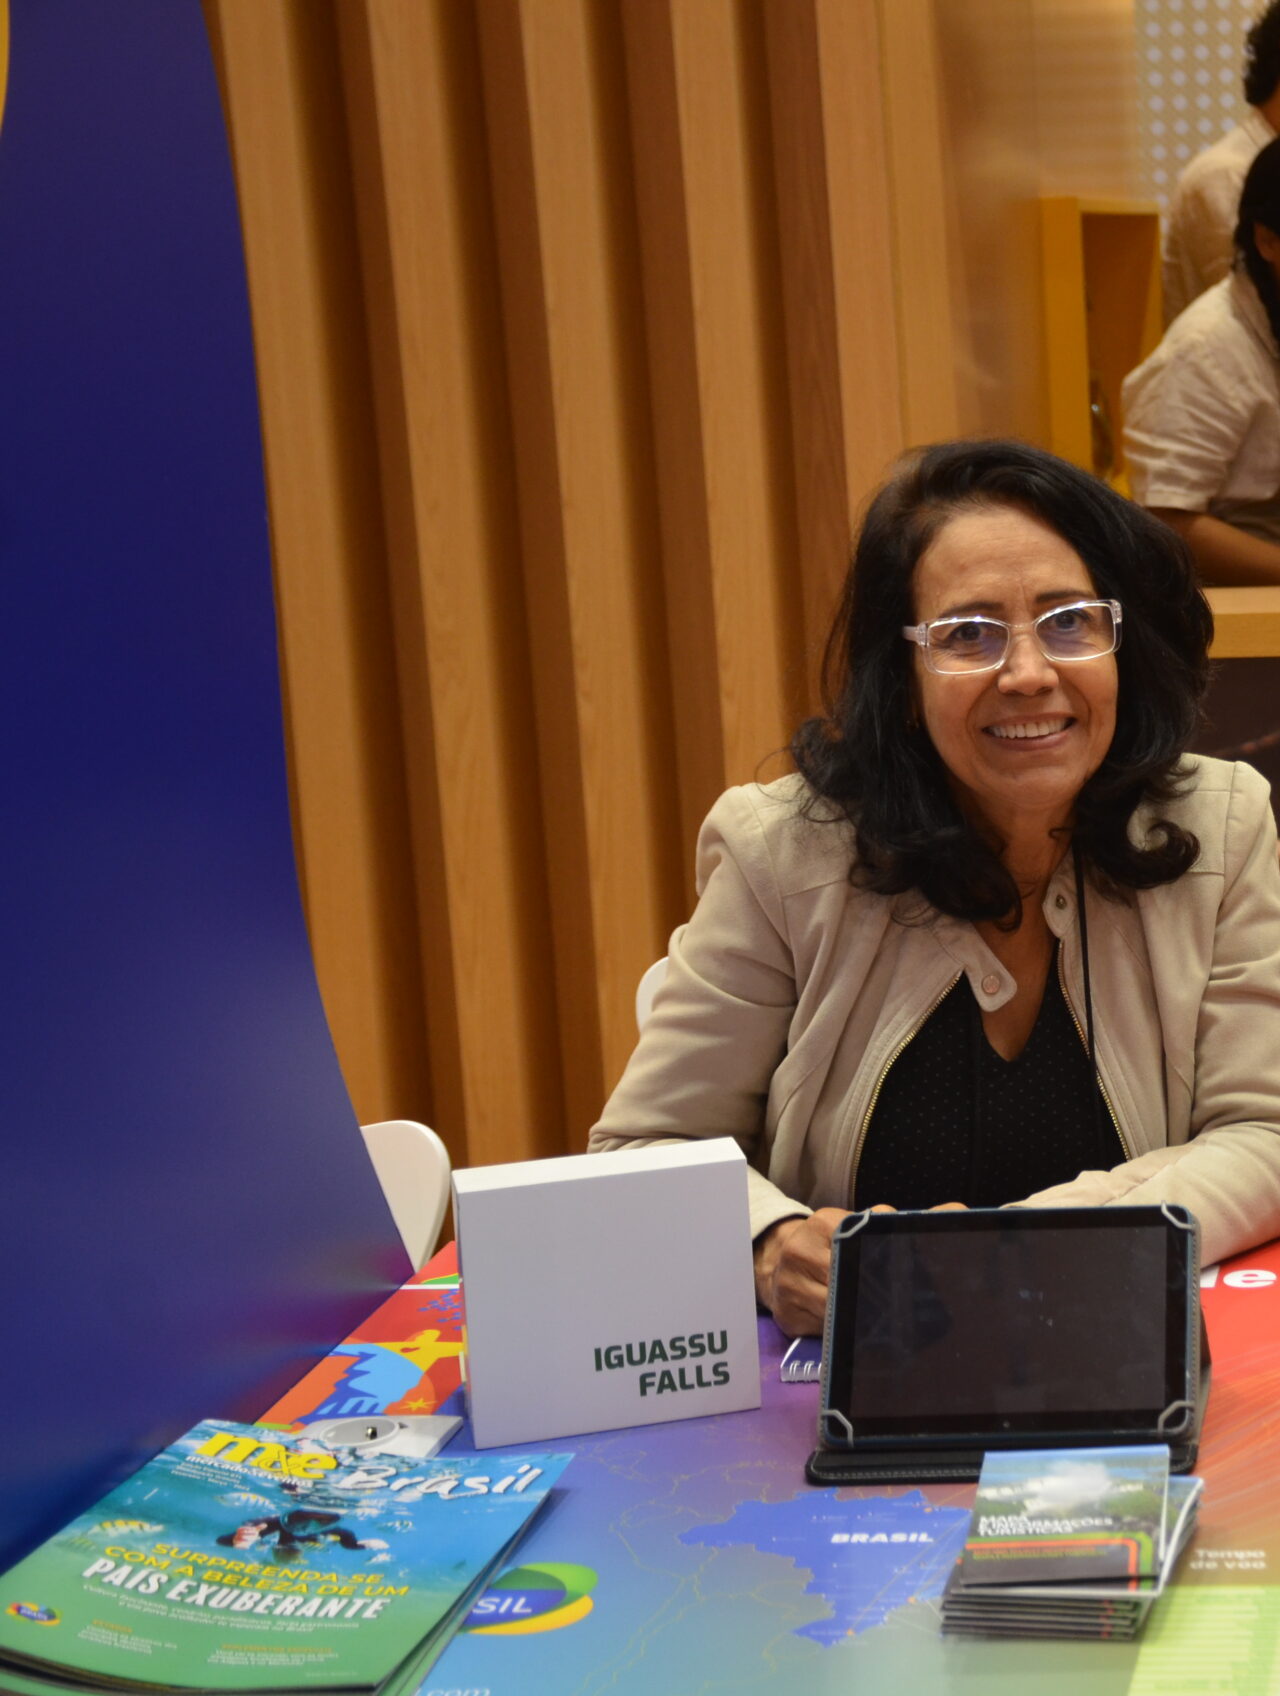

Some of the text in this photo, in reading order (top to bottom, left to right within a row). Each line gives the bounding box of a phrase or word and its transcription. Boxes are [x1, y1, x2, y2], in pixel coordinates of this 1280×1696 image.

[594, 1330, 728, 1371] IGUASSU
[639, 1362, 730, 1396] FALLS
[333, 1463, 544, 1500] Brasil
[830, 1532, 934, 1544] BRASIL
[1196, 1549, 1266, 1560] Tempo
[104, 1545, 410, 1597] COM A BELEZA DE UM
[152, 1543, 385, 1584] SURPREENDA-SE
[1189, 1560, 1266, 1569] de voo
[165, 1579, 392, 1619] EXUBERANTE
